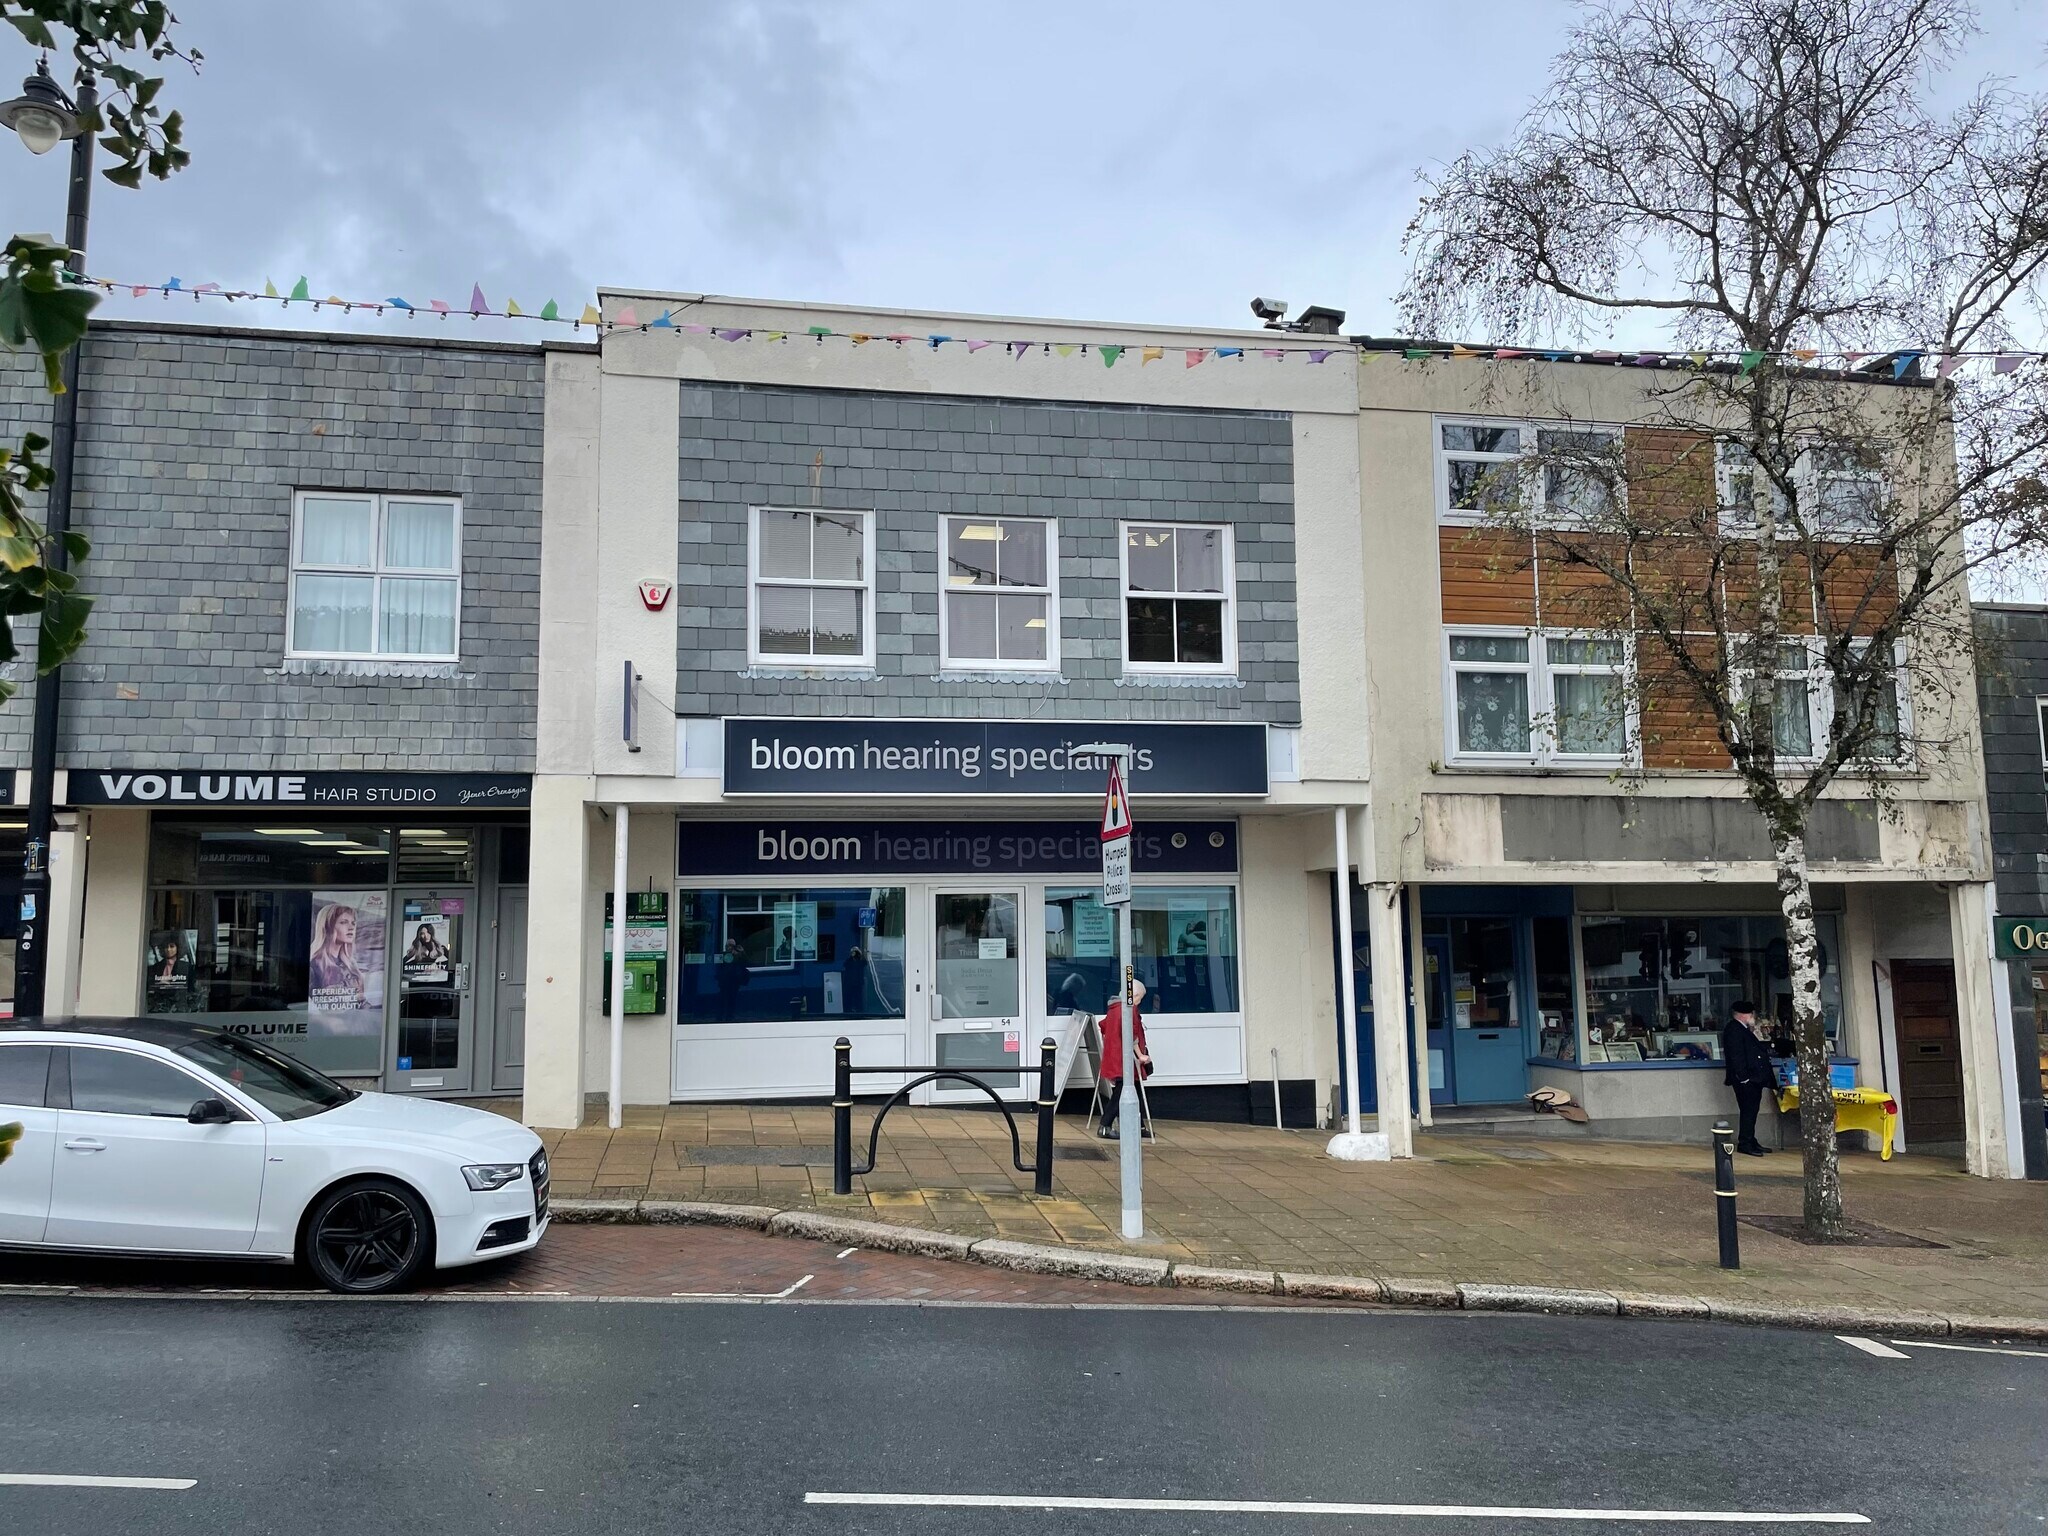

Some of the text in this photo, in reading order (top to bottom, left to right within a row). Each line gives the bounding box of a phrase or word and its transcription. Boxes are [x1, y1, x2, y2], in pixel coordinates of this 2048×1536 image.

[751, 738, 1155, 778] bloom hearing specialits
[99, 775, 437, 801] VOLUME HAIR STUDIO
[758, 829, 862, 861] bloom
[873, 830, 991, 867] hearing
[1105, 844, 1127, 861] Humped
[1106, 865, 1126, 879] Pelican
[1105, 881, 1128, 897] Crossing
[312, 987, 356, 996] EXPERIENCE
[312, 994, 358, 1003] IRRESISTIBLE
[331, 1002, 362, 1011] QUALITY
[222, 1023, 308, 1035] VOLUME
